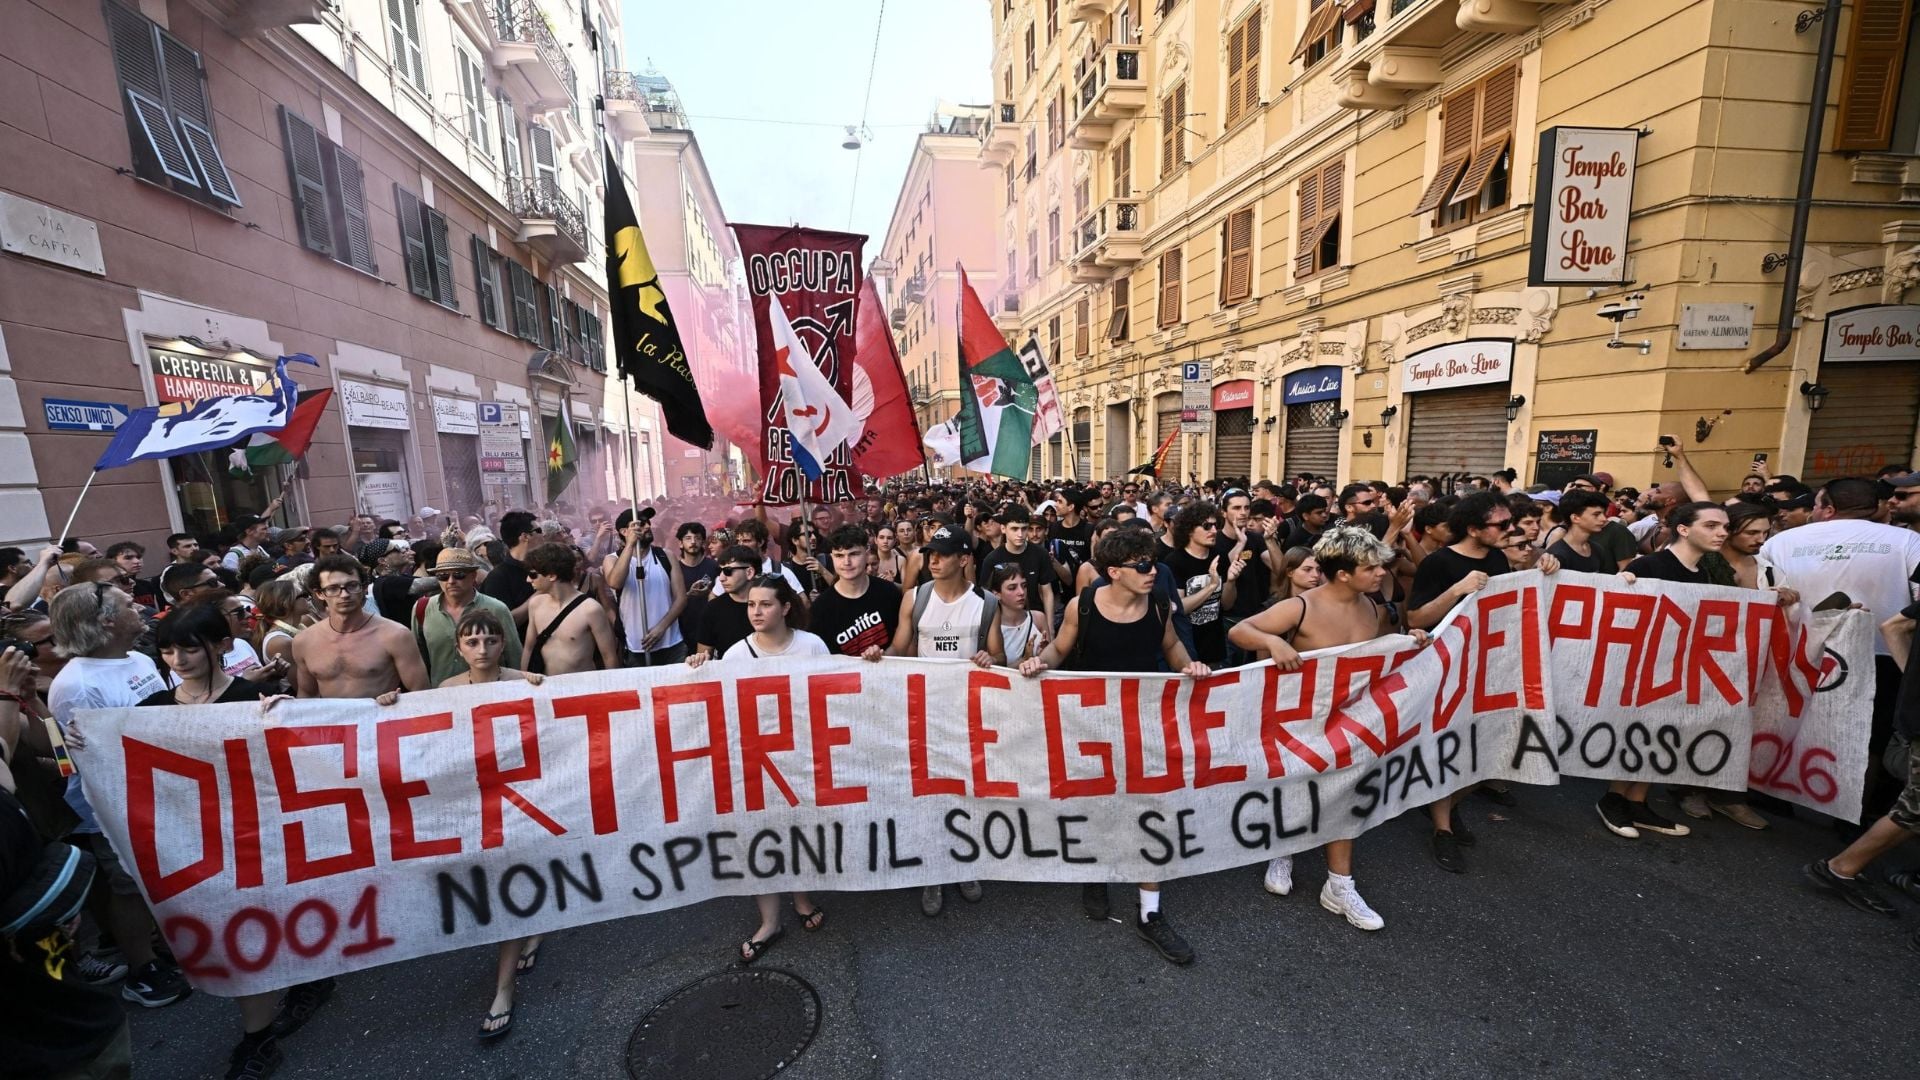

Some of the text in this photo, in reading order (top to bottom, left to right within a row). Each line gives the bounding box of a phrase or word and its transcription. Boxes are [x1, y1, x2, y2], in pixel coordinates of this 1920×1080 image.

[1562, 145, 1627, 189] Temple
[1559, 185, 1608, 223] Bar
[38, 216, 64, 233] VIA
[29, 234, 81, 258] CAFFA
[1560, 229, 1616, 272] Lino
[750, 247, 854, 296] OCCUPA
[1683, 326, 1749, 337] GAETANO ALIMONDA
[1839, 322, 1884, 355] Temple
[1886, 324, 1915, 347] Bar
[160, 356, 236, 384] CREPERIA
[240, 369, 250, 385] &
[1410, 352, 1502, 385] Temple Bar Lino
[1288, 381, 1317, 396] Musica
[47, 405, 114, 424] SENSO UNICO
[381, 400, 406, 412] BEAUTY
[836, 611, 882, 645] antifa
[935, 641, 958, 651] NETS
[122, 672, 868, 905] DISERTARE
[907, 671, 1019, 798] LE
[1041, 647, 1426, 799] GUERRE
[1432, 586, 1546, 733] DEI
[436, 852, 604, 934] NON
[630, 821, 844, 901] SPEGNI
[868, 818, 923, 872] IL
[944, 806, 1097, 864] SOLE
[1139, 808, 1205, 866] SE
[1231, 780, 1321, 850] GLI
[1352, 722, 1478, 818] SPARI
[161, 884, 395, 982] 2001
